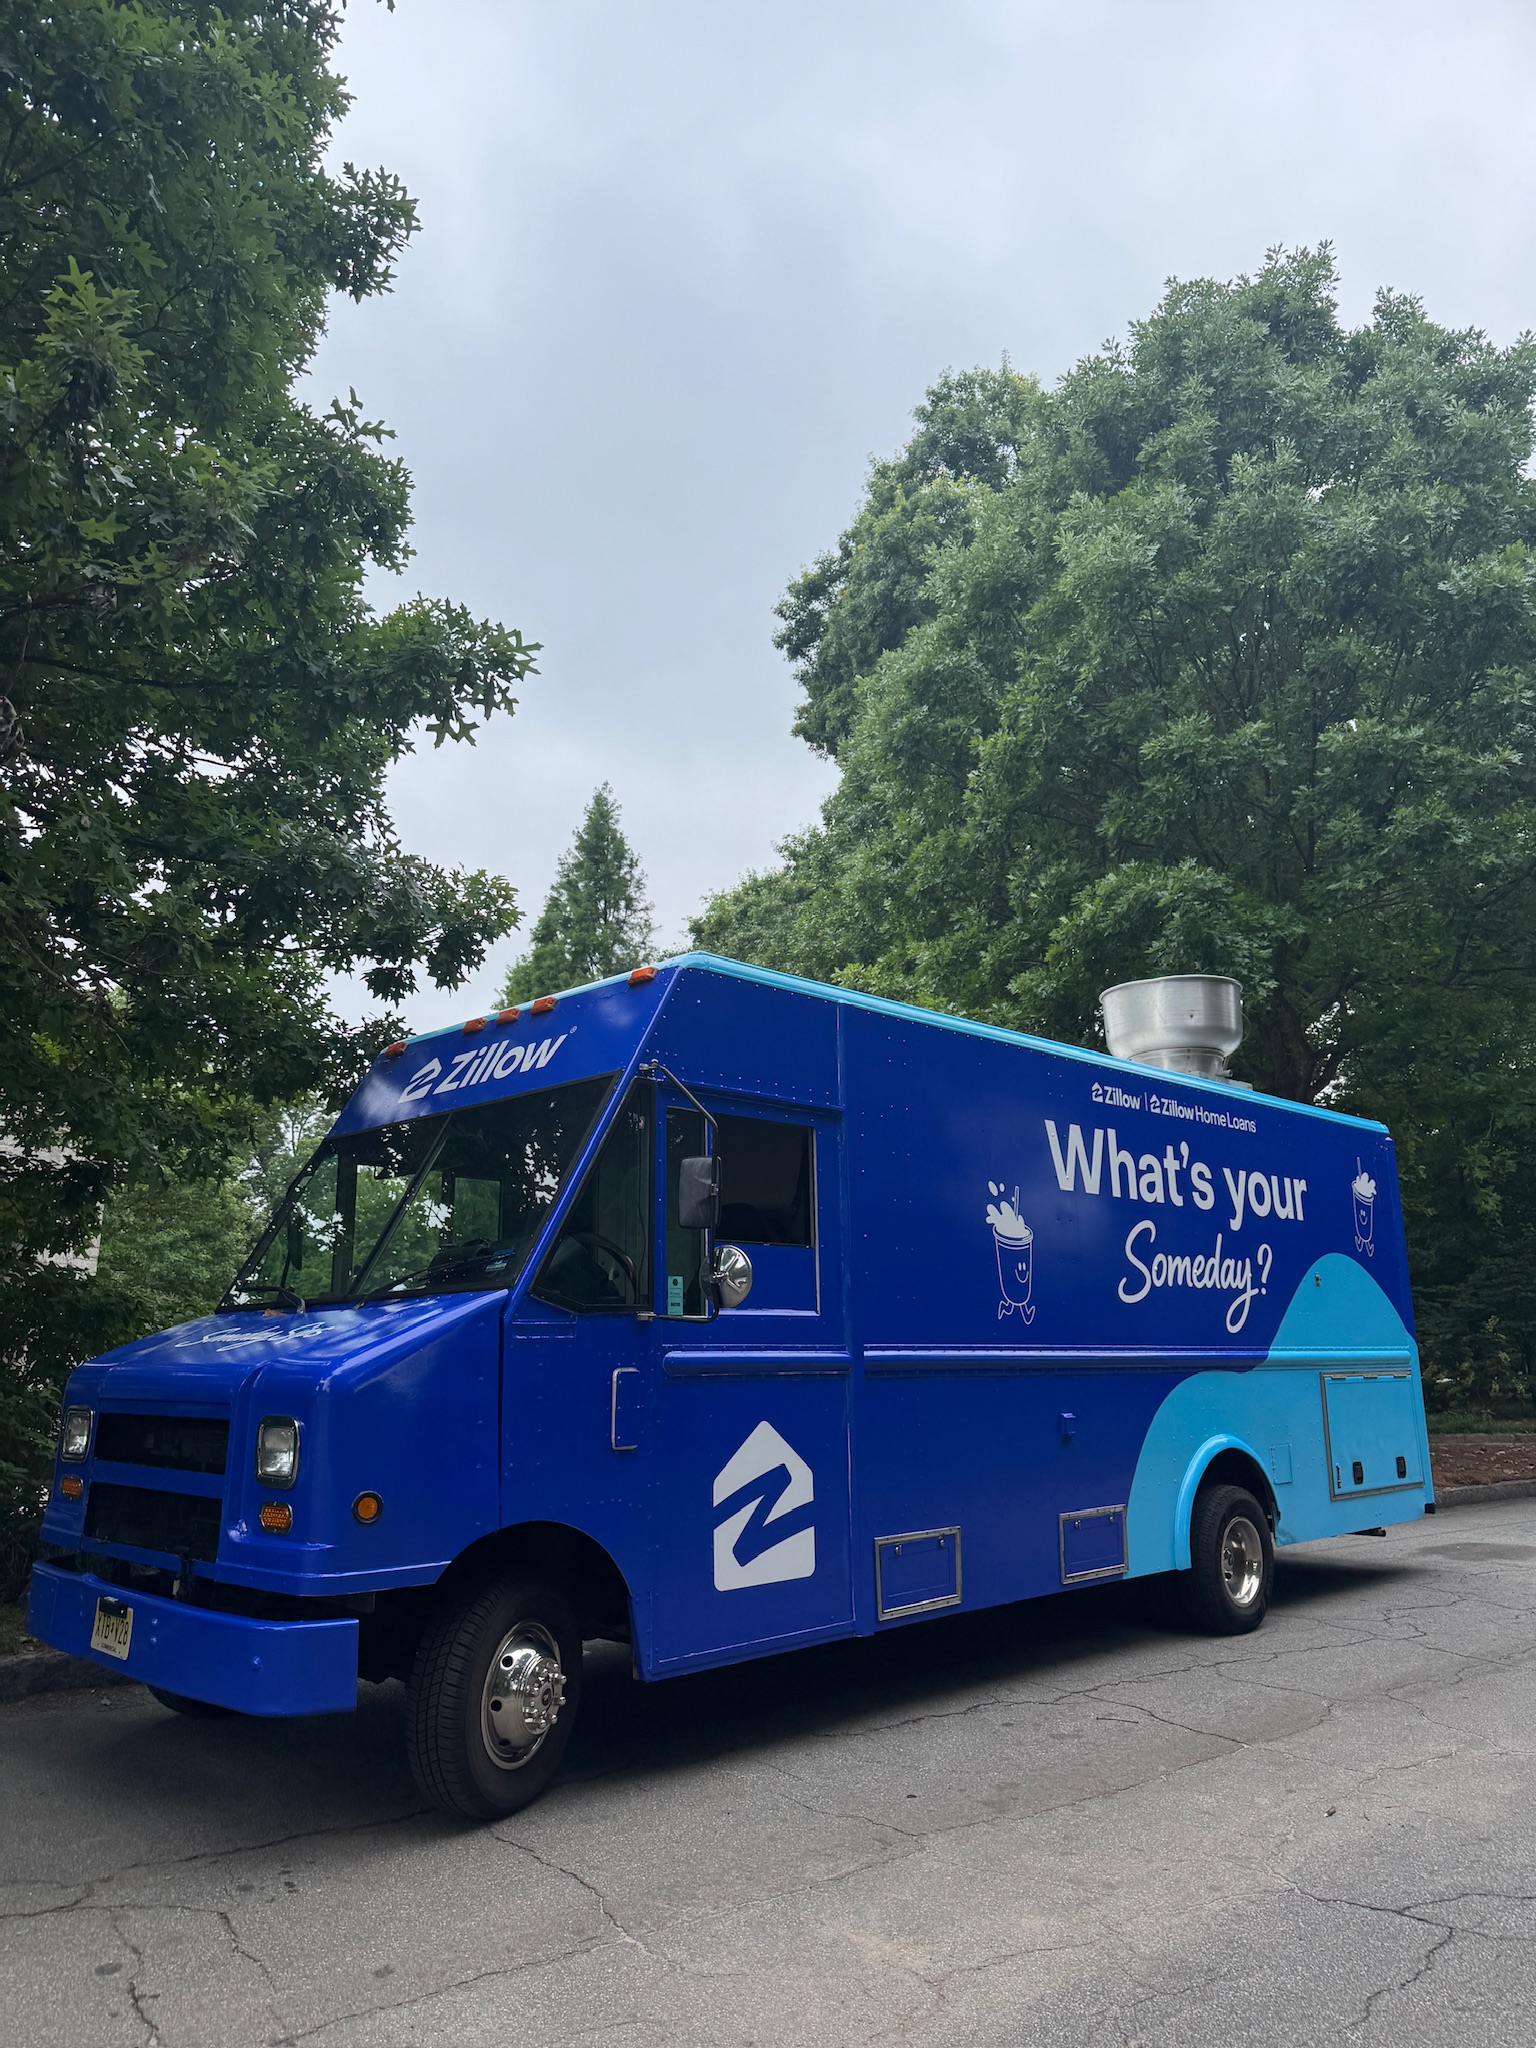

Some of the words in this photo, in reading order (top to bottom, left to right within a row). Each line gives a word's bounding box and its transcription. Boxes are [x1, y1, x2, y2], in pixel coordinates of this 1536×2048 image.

[1103, 1085, 1141, 1110] Zillow
[1160, 1098, 1194, 1121] Zillow
[1044, 1119, 1215, 1211] What's
[1221, 1165, 1307, 1232] your
[1118, 1219, 1273, 1334] Someday?
